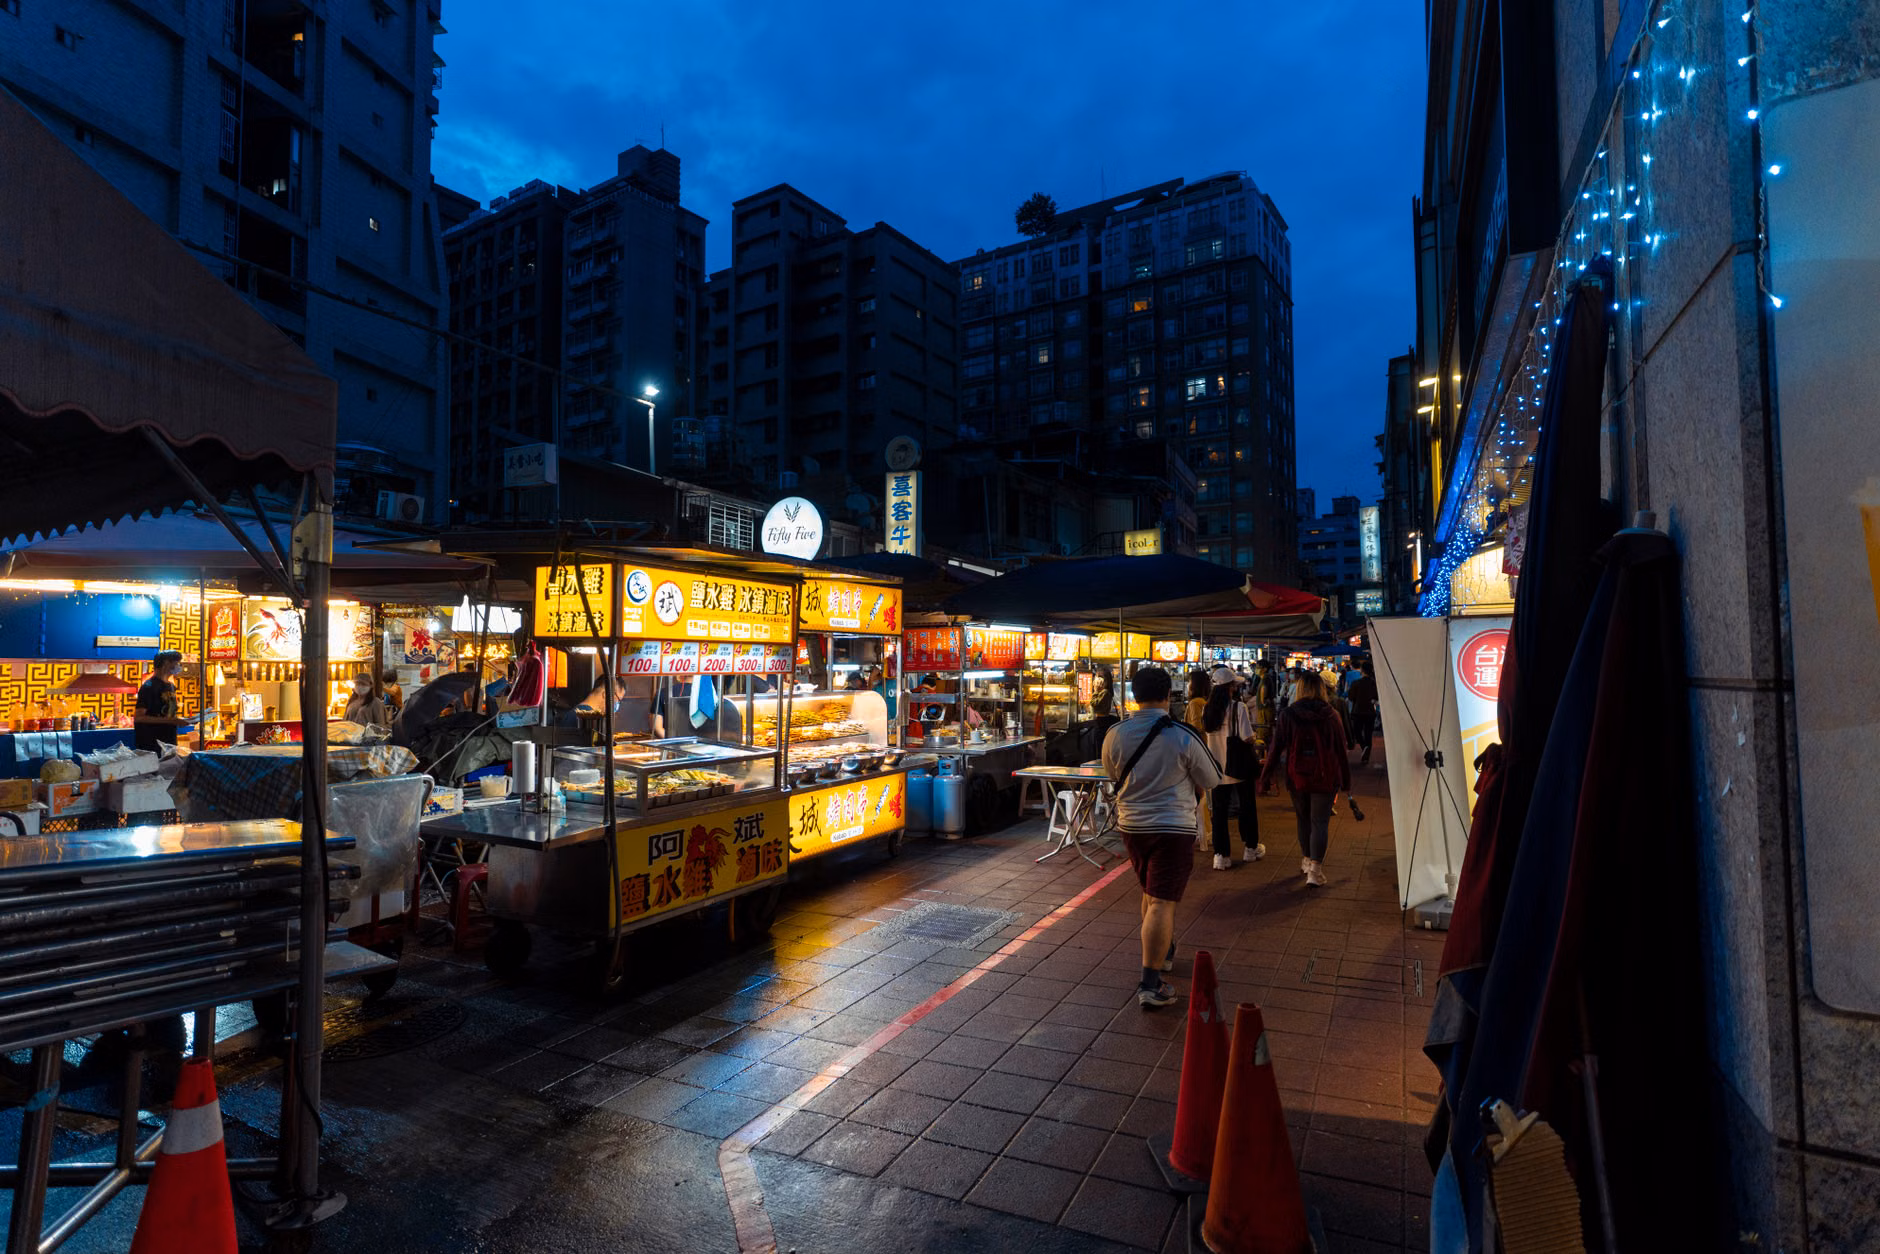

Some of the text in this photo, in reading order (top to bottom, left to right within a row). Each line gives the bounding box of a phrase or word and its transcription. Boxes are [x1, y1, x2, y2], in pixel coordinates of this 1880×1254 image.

[890, 475, 913, 555] 喜客牛
[768, 526, 817, 546] Fifty Five
[690, 581, 791, 617] 鹽水雞 冰鎮滷味
[1475, 644, 1507, 666] 台
[648, 829, 685, 866] 阿
[621, 838, 783, 920] 鹽水雞 滷味
